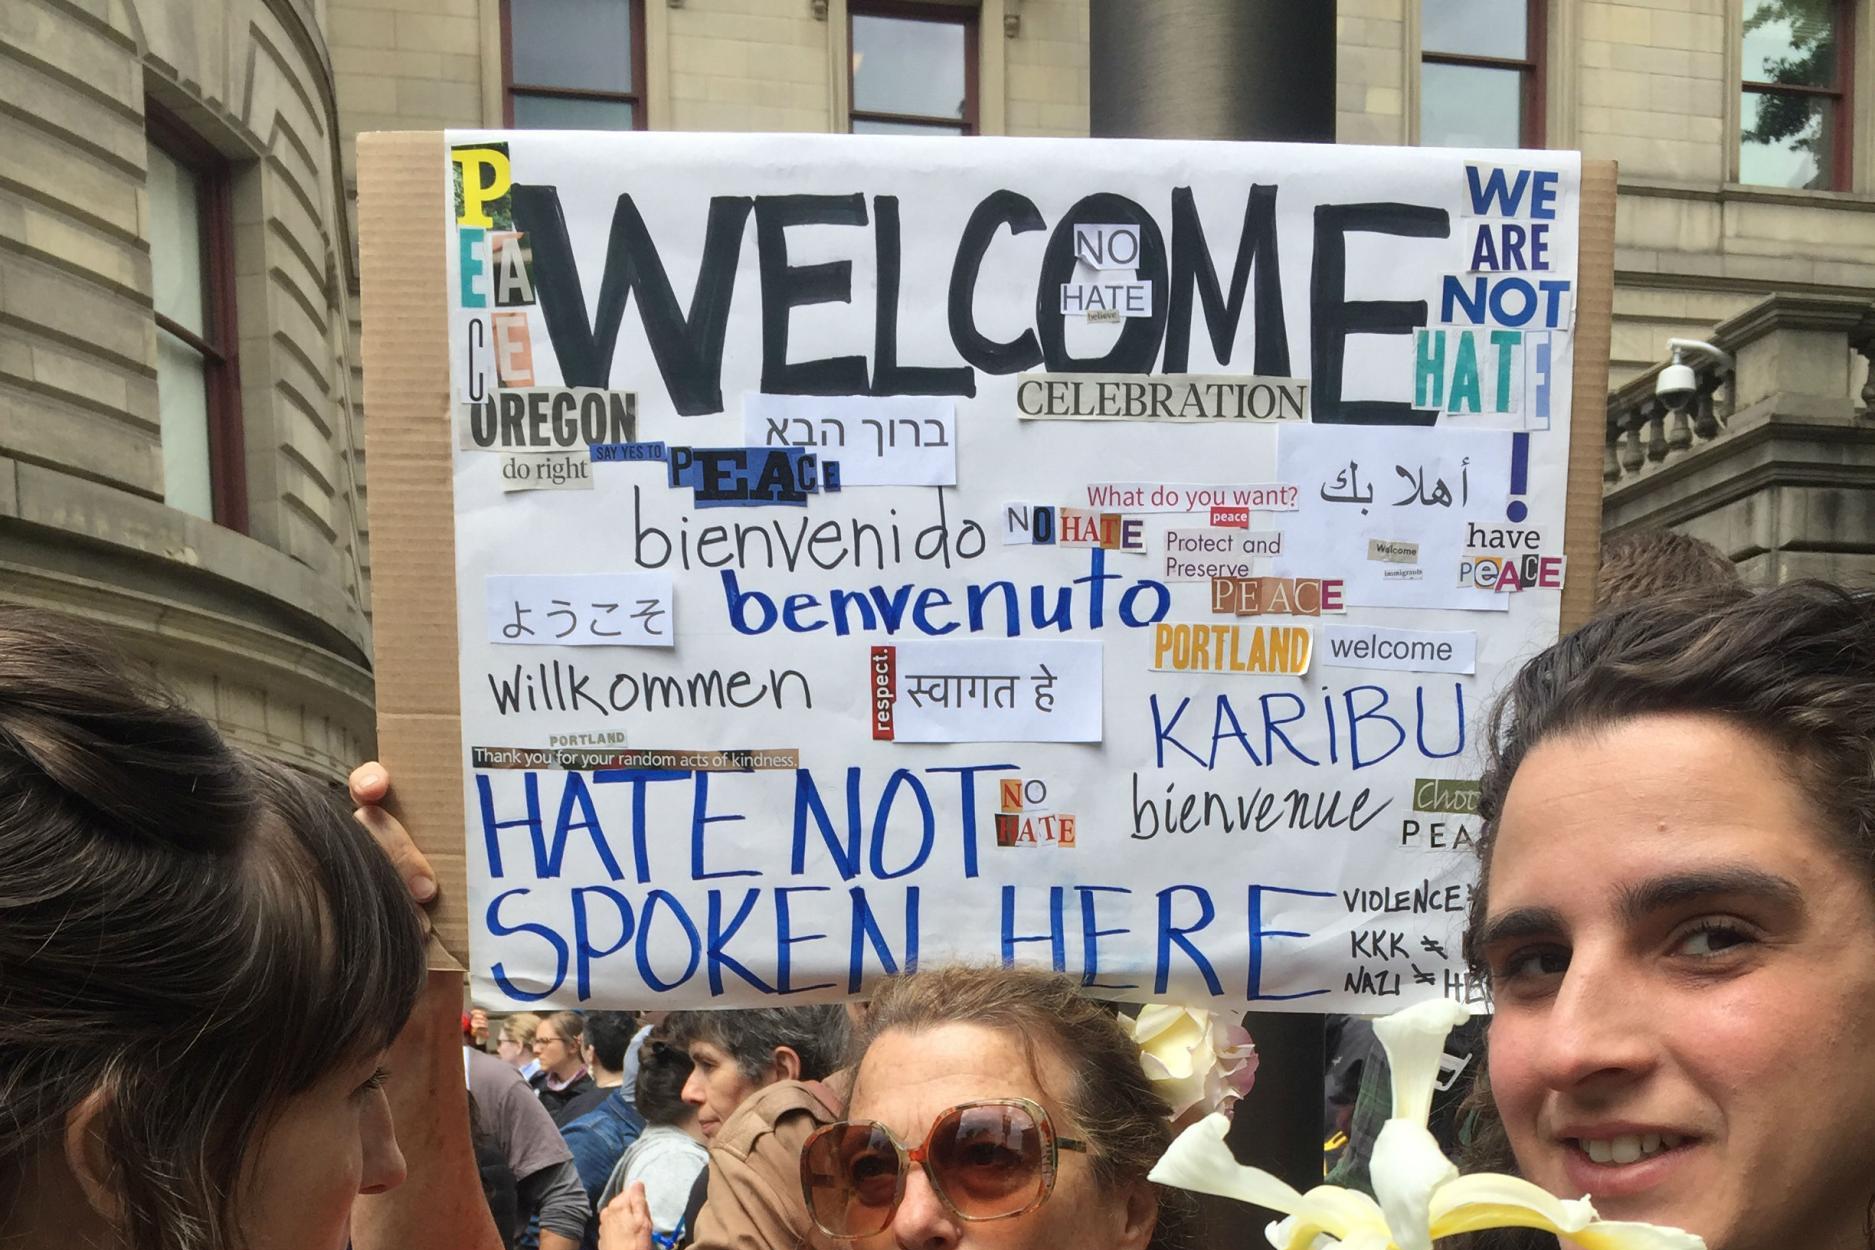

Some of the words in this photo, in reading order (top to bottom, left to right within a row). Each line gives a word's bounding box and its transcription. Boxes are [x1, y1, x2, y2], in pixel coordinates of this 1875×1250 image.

[1465, 165, 1559, 220] WE
[1077, 229, 1138, 265] NO
[1471, 224, 1549, 271] ARE
[511, 183, 1450, 426] WELCOME
[1063, 285, 1144, 312] HATE
[1440, 275, 1570, 327] NOT
[1415, 330, 1550, 429] HATE
[1017, 380, 1307, 420] CELEBRATION
[470, 392, 637, 447] OREGON
[766, 418, 845, 447] הבא
[597, 447, 617, 461] SAY
[621, 446, 646, 460] YES
[650, 445, 662, 459] TO
[862, 419, 949, 457] ברוך
[503, 460, 530, 480] do
[537, 459, 588, 489] right
[671, 447, 838, 501] PEACE
[1320, 460, 1373, 516] بك
[1391, 457, 1469, 508] أهلا
[1088, 486, 1144, 507] What
[1152, 485, 1179, 507] do
[1186, 491, 1226, 512] you
[1234, 487, 1298, 508] want?
[634, 485, 986, 572] bienvenido
[1008, 507, 1050, 542] NO
[1060, 515, 1143, 548] HATE
[1213, 511, 1247, 524] peace
[1167, 532, 1232, 552] Protect
[1243, 533, 1281, 555] and
[1467, 523, 1540, 549] have
[1167, 557, 1249, 578] Preserve
[720, 547, 1171, 637] benvenuto
[1213, 579, 1344, 614] PEACE
[502, 600, 666, 639] ようこそ
[1154, 623, 1309, 673] PORTLAND
[1331, 634, 1453, 661] welcome
[873, 648, 894, 732] respect.
[905, 675, 1021, 709] स्वागत
[550, 732, 625, 747] PORTLAND
[476, 749, 521, 764] Thank
[524, 753, 551, 768] you
[556, 750, 577, 764] for
[581, 754, 615, 769] your
[619, 751, 674, 767] random
[680, 754, 708, 767] acts
[713, 751, 729, 767] of
[732, 752, 797, 768] kindness.
[1003, 780, 1047, 807] NO
[1131, 772, 1394, 839] bienvenue
[476, 768, 763, 883] HATE
[790, 764, 1021, 881] NOT
[998, 815, 1076, 843] HATE
[1402, 820, 1475, 850] PEA
[1343, 879, 1465, 914] VIOLENCE
[486, 885, 920, 1002] SPOKEN
[1000, 885, 1337, 1001] HERE
[1351, 929, 1409, 961] KKK
[1344, 965, 1401, 996] NAZI
